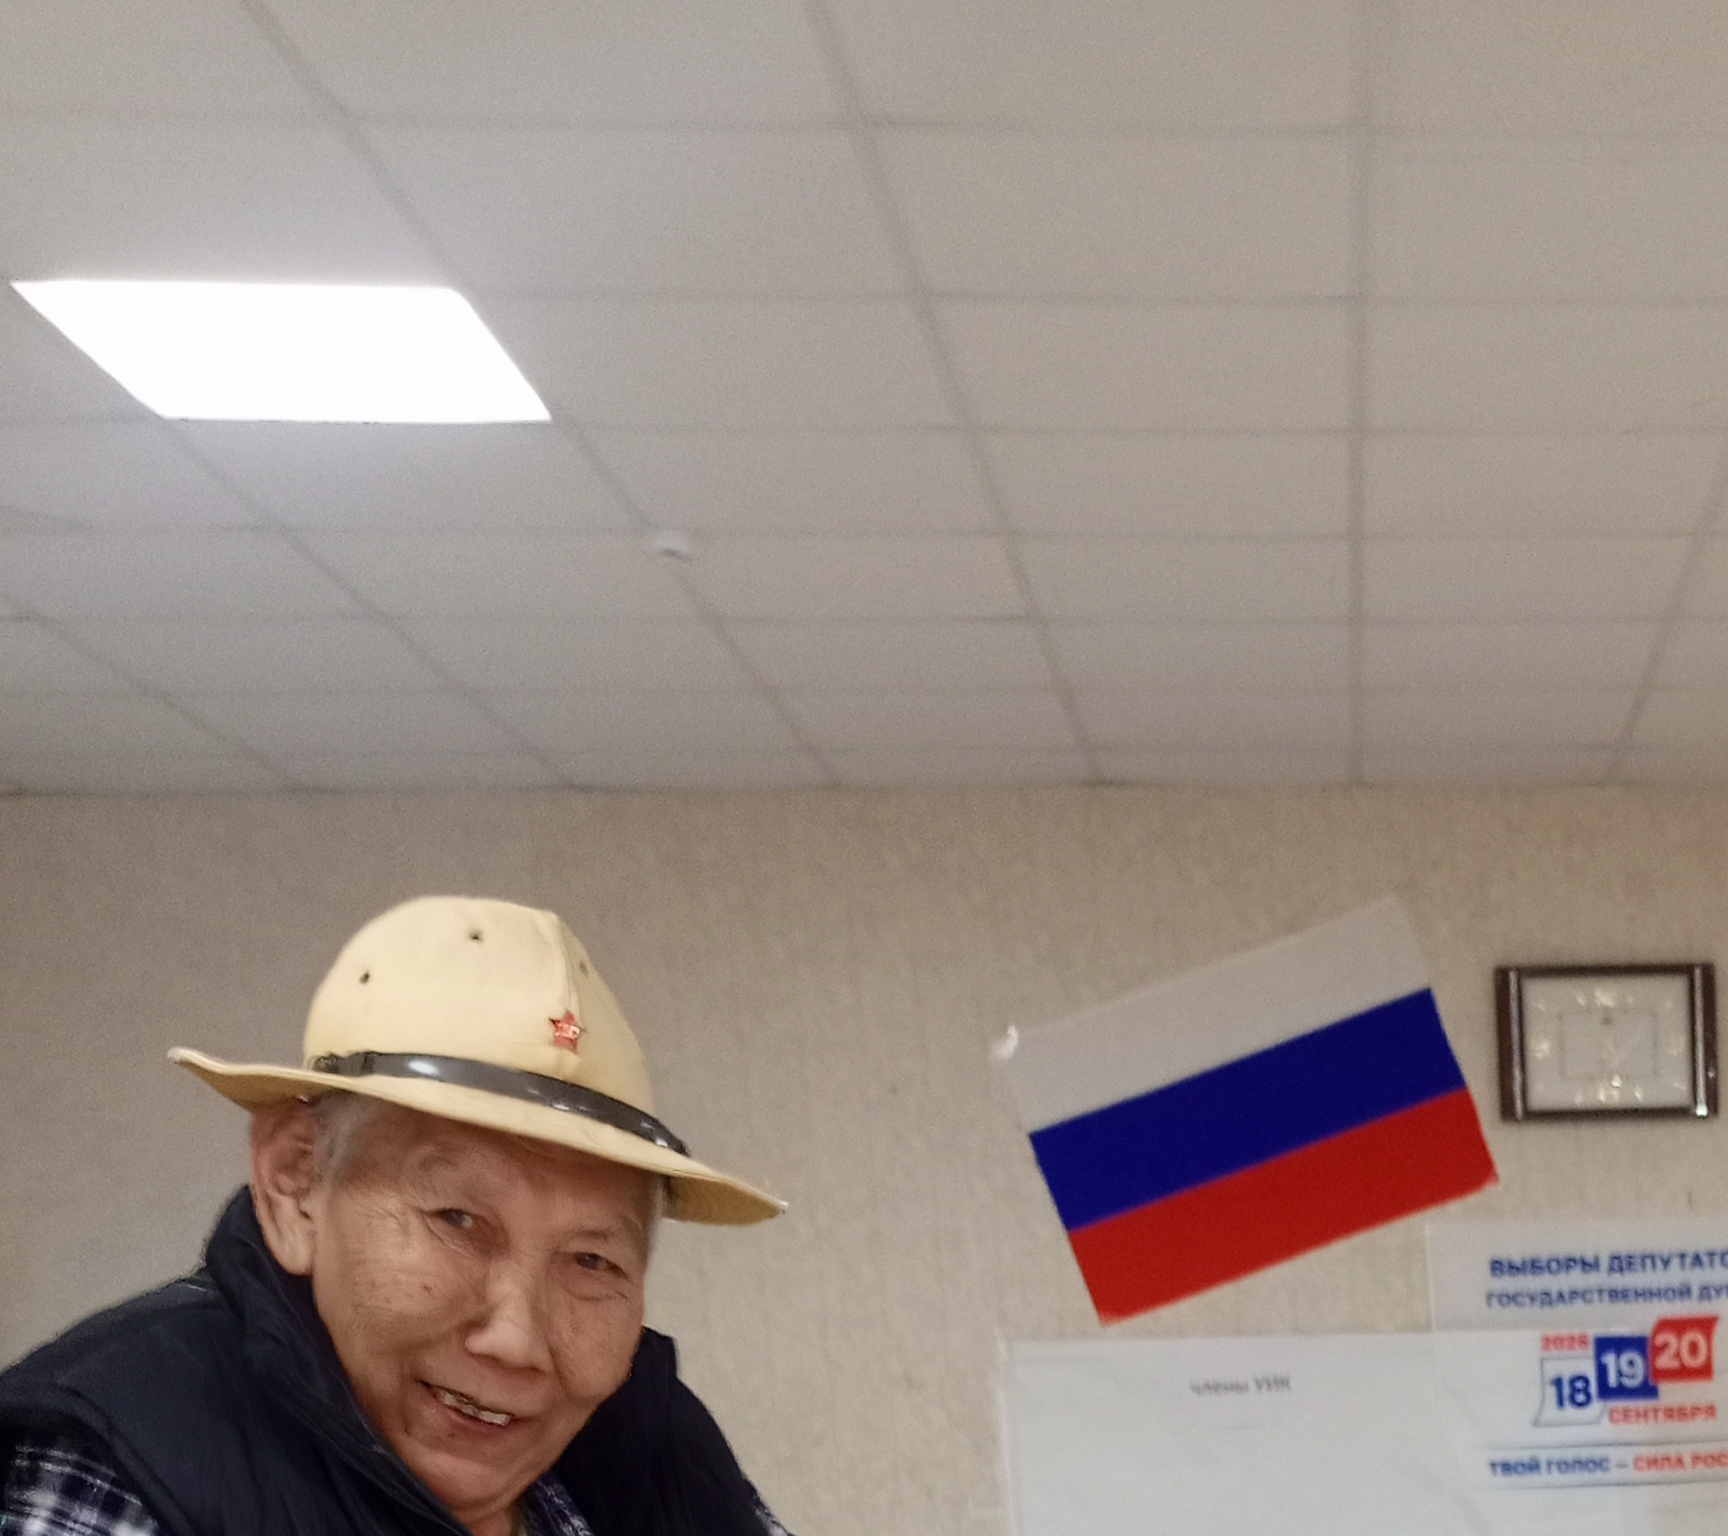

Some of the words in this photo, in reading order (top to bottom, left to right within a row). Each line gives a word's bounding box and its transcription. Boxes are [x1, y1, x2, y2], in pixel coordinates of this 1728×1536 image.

[1491, 1256, 1600, 1276] ВЫБОРЫ
[1487, 1284, 1692, 1308] ГОСУДАРСТВЕННОЙ
[1551, 1375, 1592, 1409] 18
[1601, 1351, 1645, 1389] 19
[1653, 1332, 1709, 1370] 20
[1609, 1404, 1717, 1425] СЕНТЯБРЯ
[1489, 1457, 1541, 1476] ТВОЙ
[1546, 1458, 1609, 1474] ГОЛОС
[1633, 1455, 1685, 1471] СИЛА
